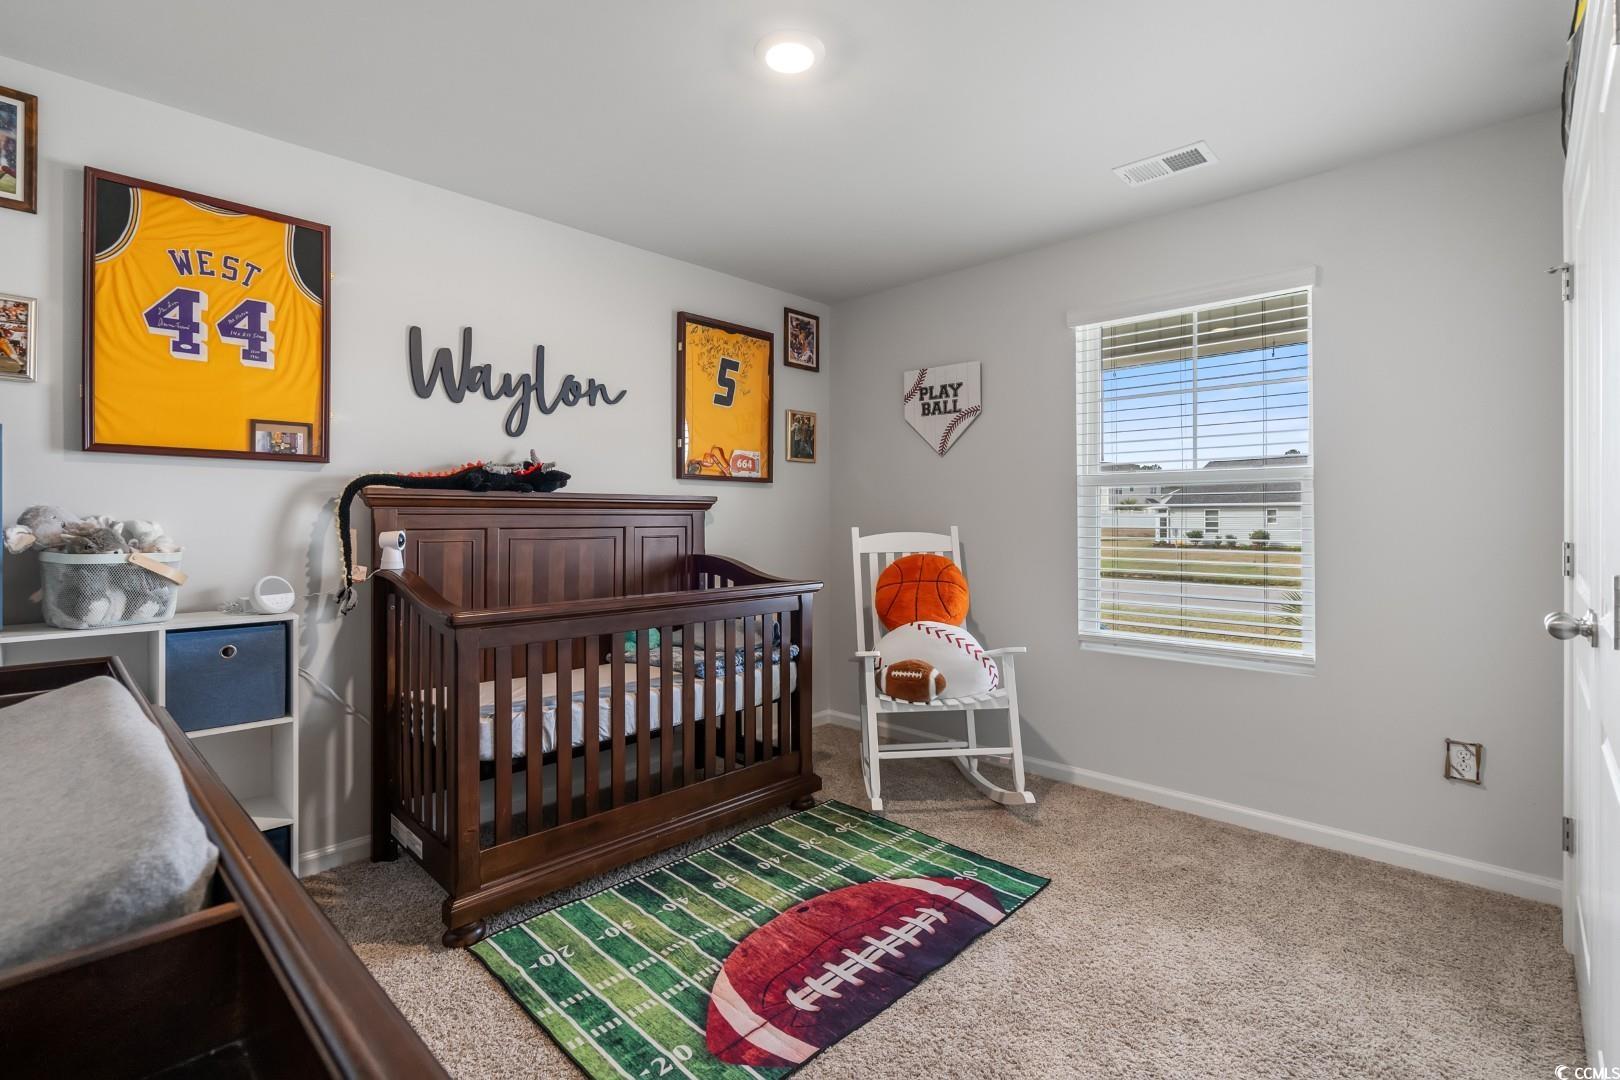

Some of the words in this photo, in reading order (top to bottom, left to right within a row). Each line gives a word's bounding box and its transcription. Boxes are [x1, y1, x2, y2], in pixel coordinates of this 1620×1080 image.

[167, 248, 262, 287] WEST
[143, 286, 275, 370] 44
[408, 325, 627, 437] Waylon
[713, 356, 741, 408] 5
[919, 381, 963, 402] PLAY
[921, 399, 962, 417] BALL
[757, 856, 779, 870] 40
[712, 874, 739, 889] 50
[662, 896, 688, 911] 40
[604, 919, 636, 938] 30
[538, 944, 575, 967] 20
[650, 1044, 693, 1077] 20
